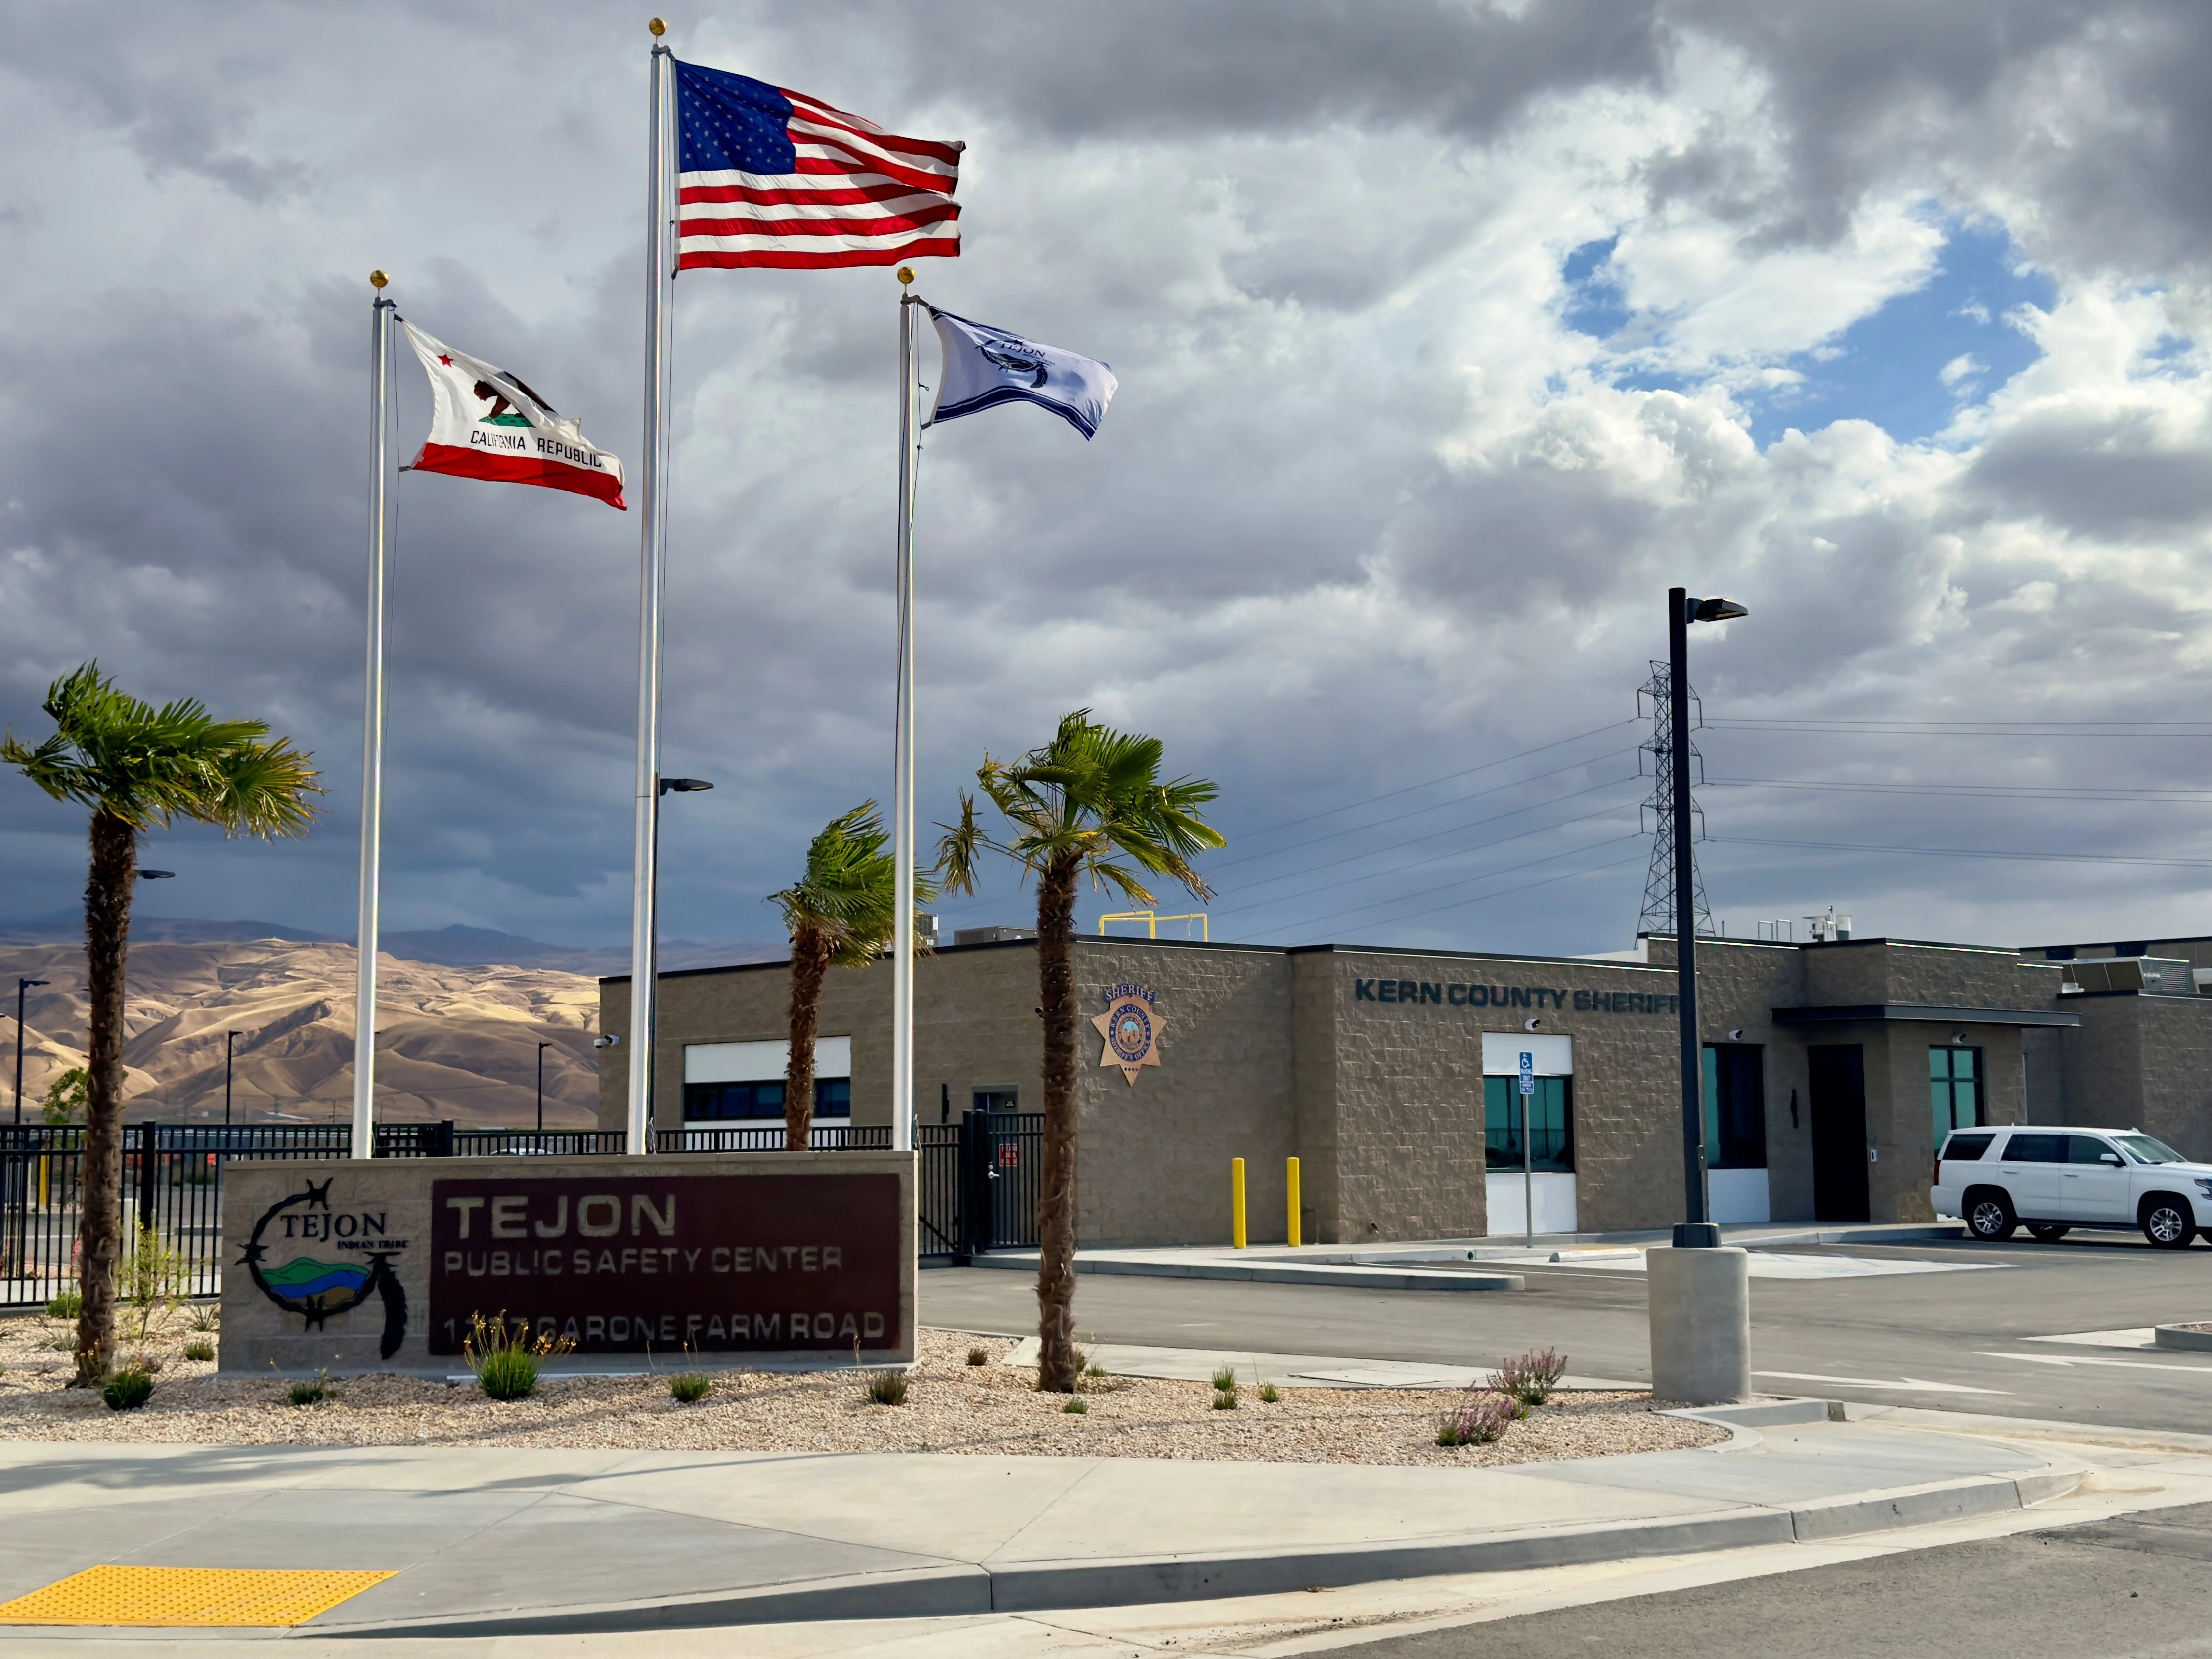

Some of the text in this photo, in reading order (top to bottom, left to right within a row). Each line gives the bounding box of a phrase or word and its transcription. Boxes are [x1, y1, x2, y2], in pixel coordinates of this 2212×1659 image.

[999, 342, 1045, 357] TEJON
[470, 430, 602, 467] CALIFORNIA REPUBLIC
[1106, 984, 1153, 1001] SHERIFF
[1355, 978, 1442, 1004] KERN
[1448, 982, 1569, 1010] COUNTY
[1110, 1005, 1150, 1028] KERN COUNTY
[280, 1212, 386, 1242] TEJON
[447, 1195, 675, 1239] TEJON
[337, 1240, 410, 1250] INDIAN TRIBE
[445, 1246, 842, 1276] PUBLIC SAFETY CENTER
[686, 1313, 780, 1341] FARM
[790, 1311, 884, 1340] ROAD
